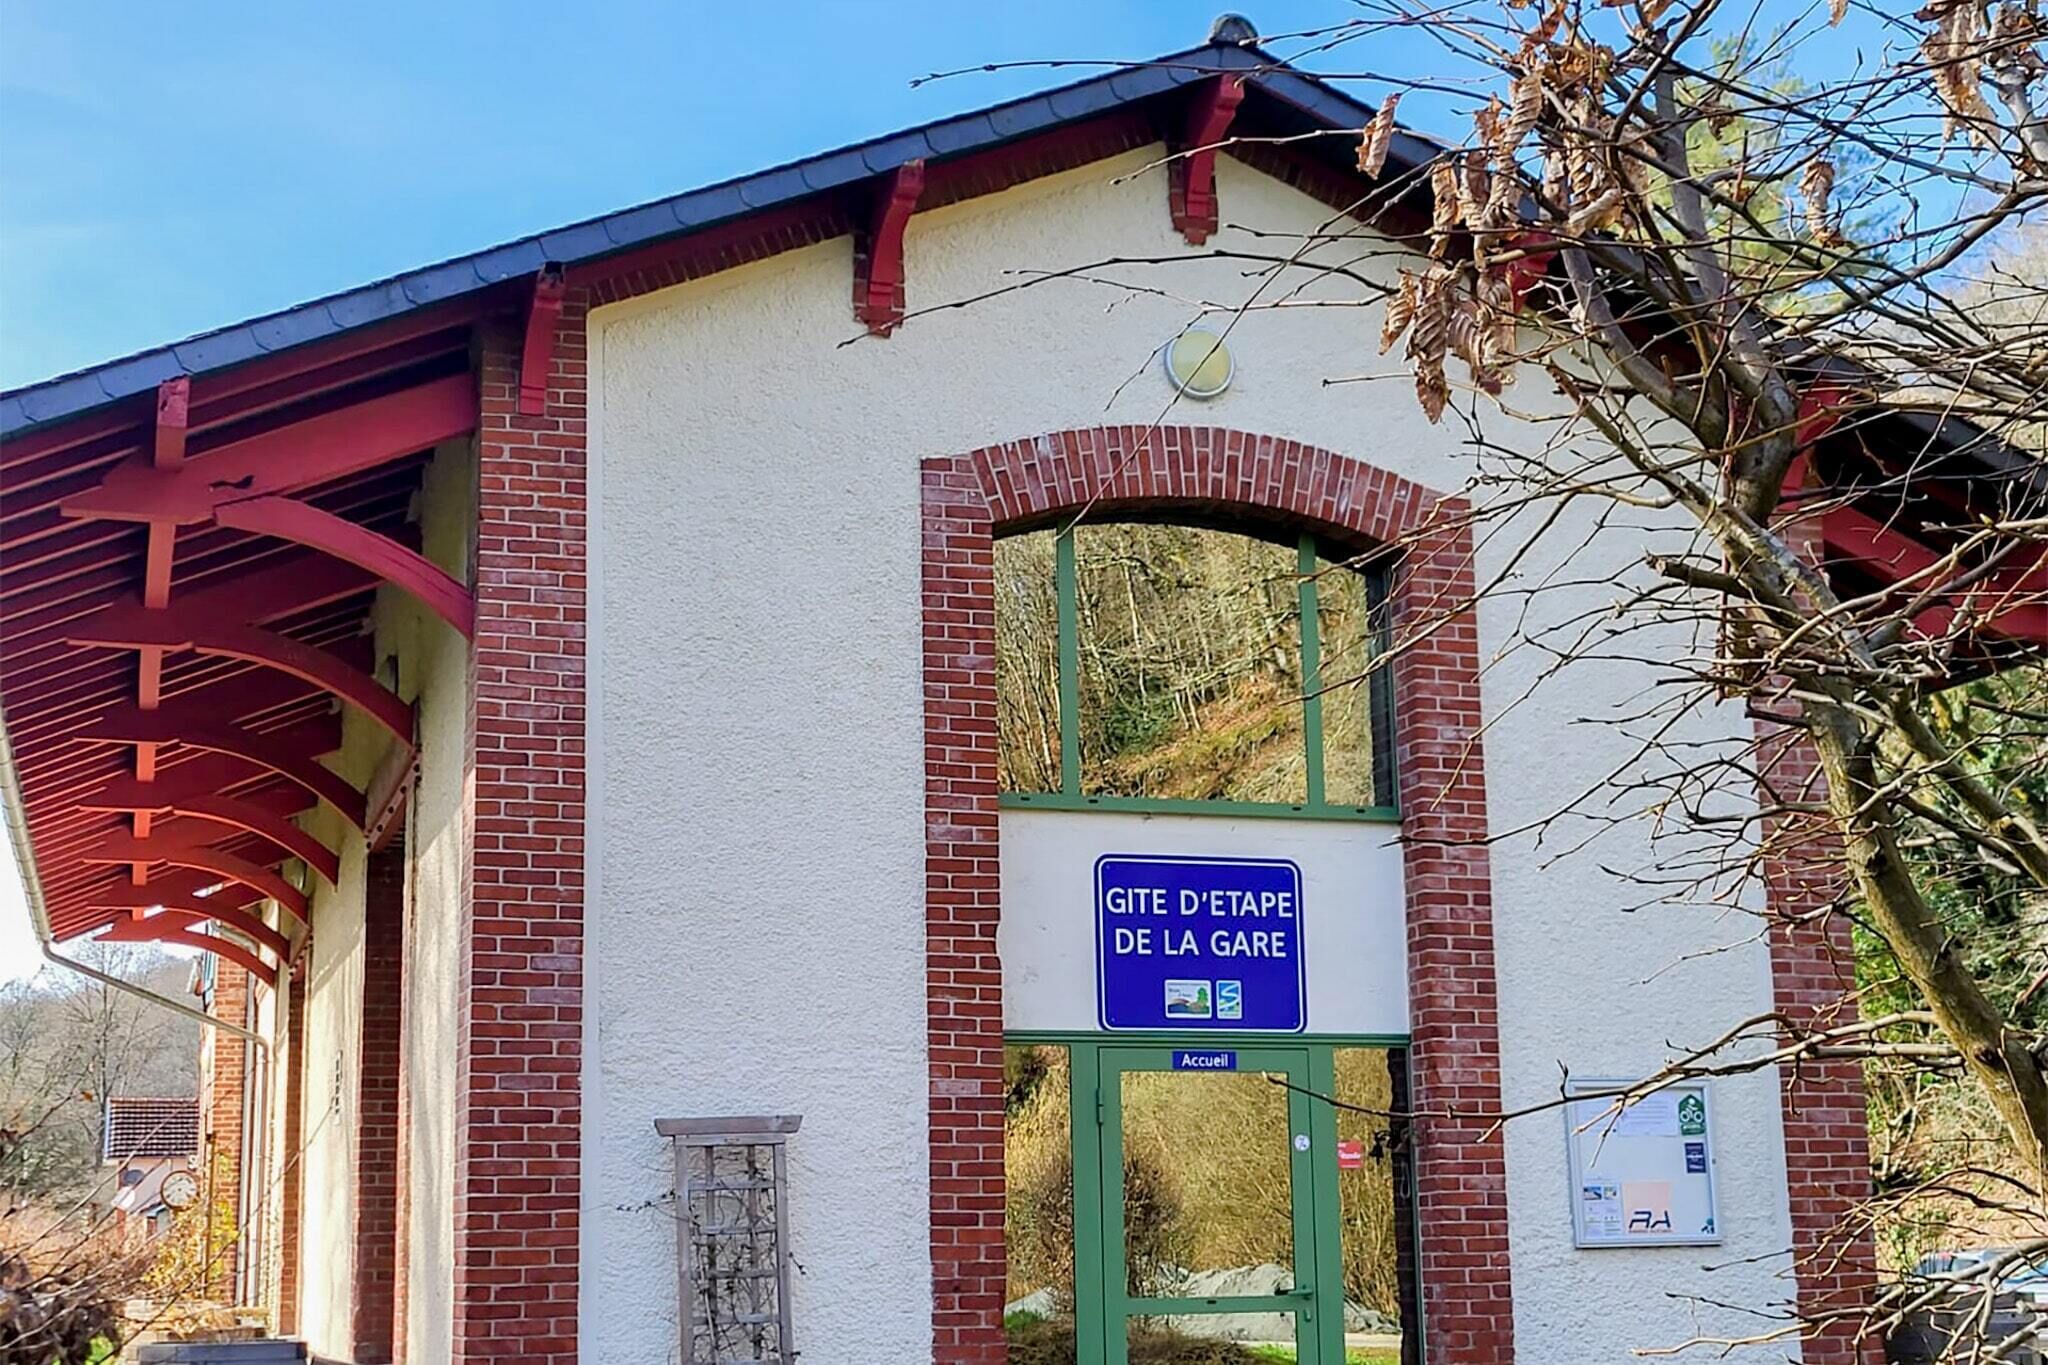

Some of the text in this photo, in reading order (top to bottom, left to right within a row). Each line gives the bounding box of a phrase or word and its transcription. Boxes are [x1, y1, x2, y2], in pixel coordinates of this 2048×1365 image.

[1106, 887, 1294, 918] GITE D'ETAPE
[1115, 928, 1287, 958] DE LA GARE
[1181, 1053, 1229, 1068] Accueil
